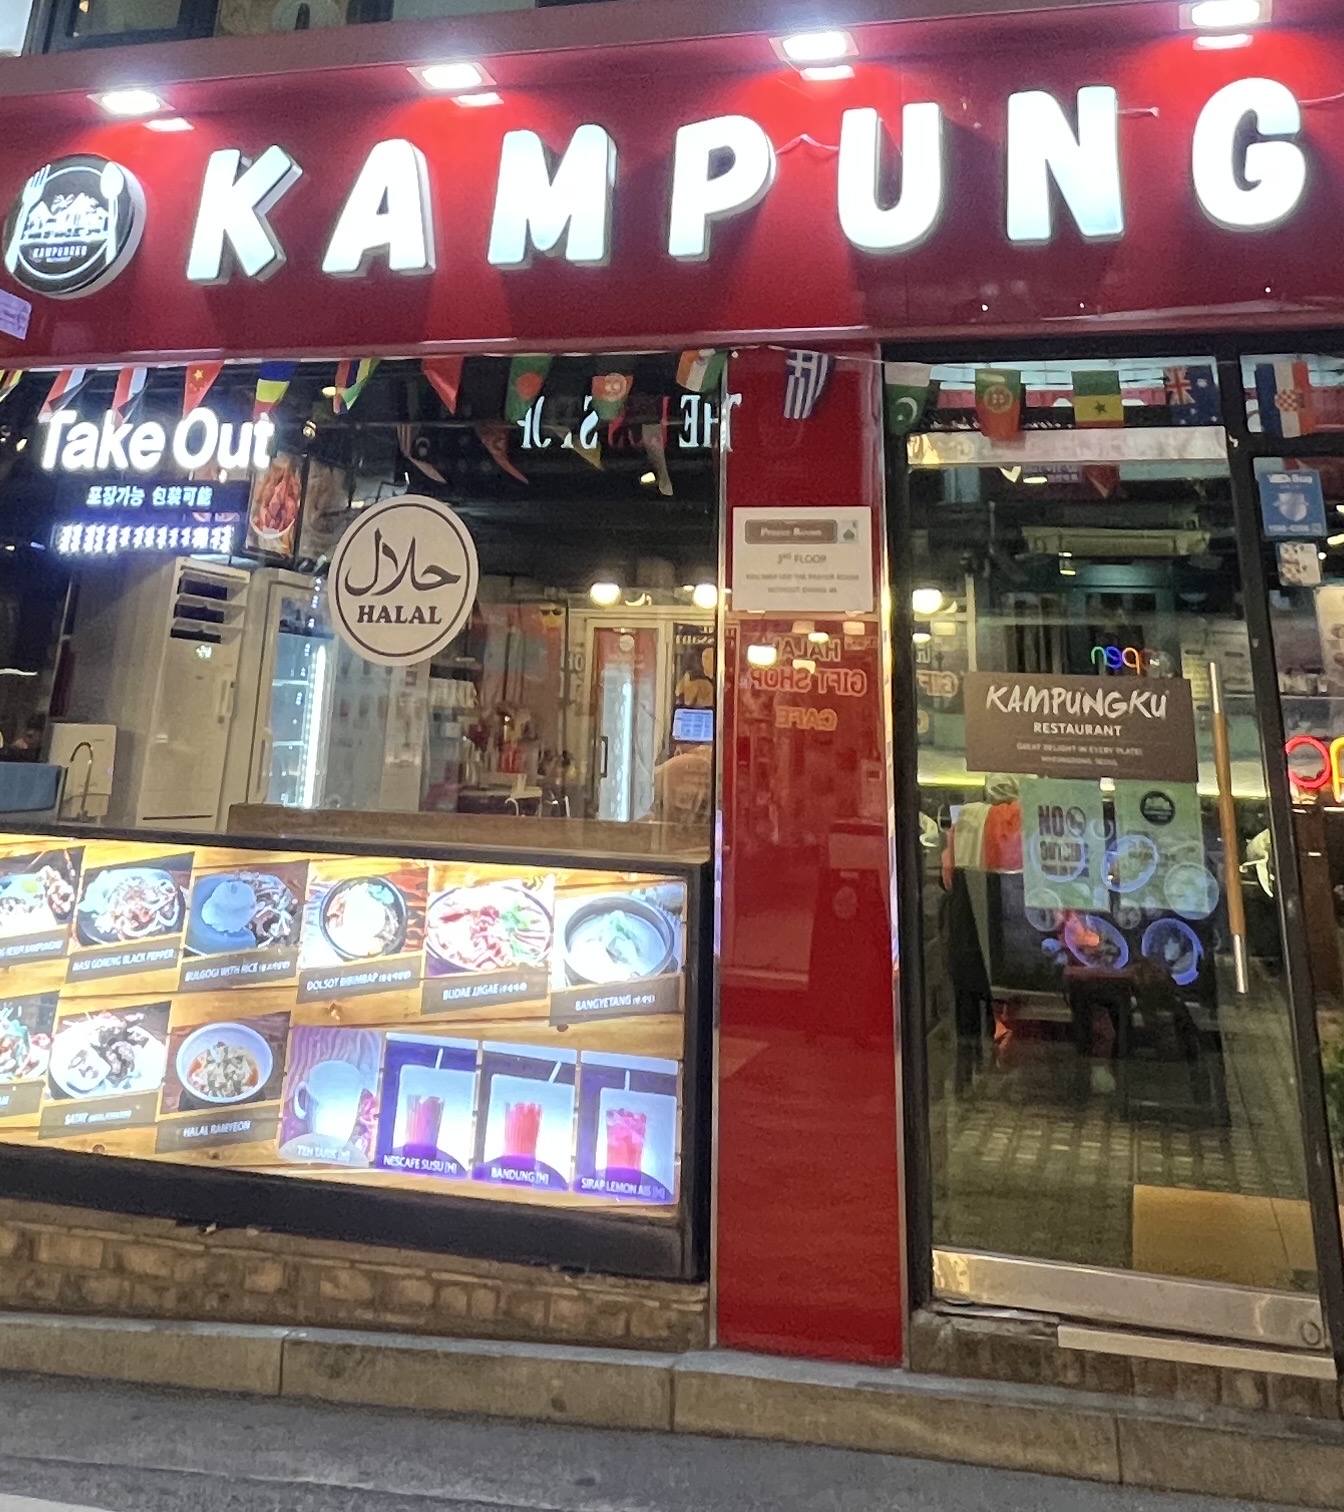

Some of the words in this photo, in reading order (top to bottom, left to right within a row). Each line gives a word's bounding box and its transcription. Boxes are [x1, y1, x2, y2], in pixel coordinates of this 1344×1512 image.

[41, 409, 166, 471] Take
[173, 407, 275, 470] Out
[344, 529, 460, 596] حلال
[356, 604, 442, 624] HALAL
[986, 683, 1170, 720] KAMPUNGKU
[1033, 722, 1122, 737] RESTAURANT
[1038, 805, 1064, 837] NO
[383, 1155, 420, 1170] NESCAFE
[491, 1167, 534, 1182] BANDUNG
